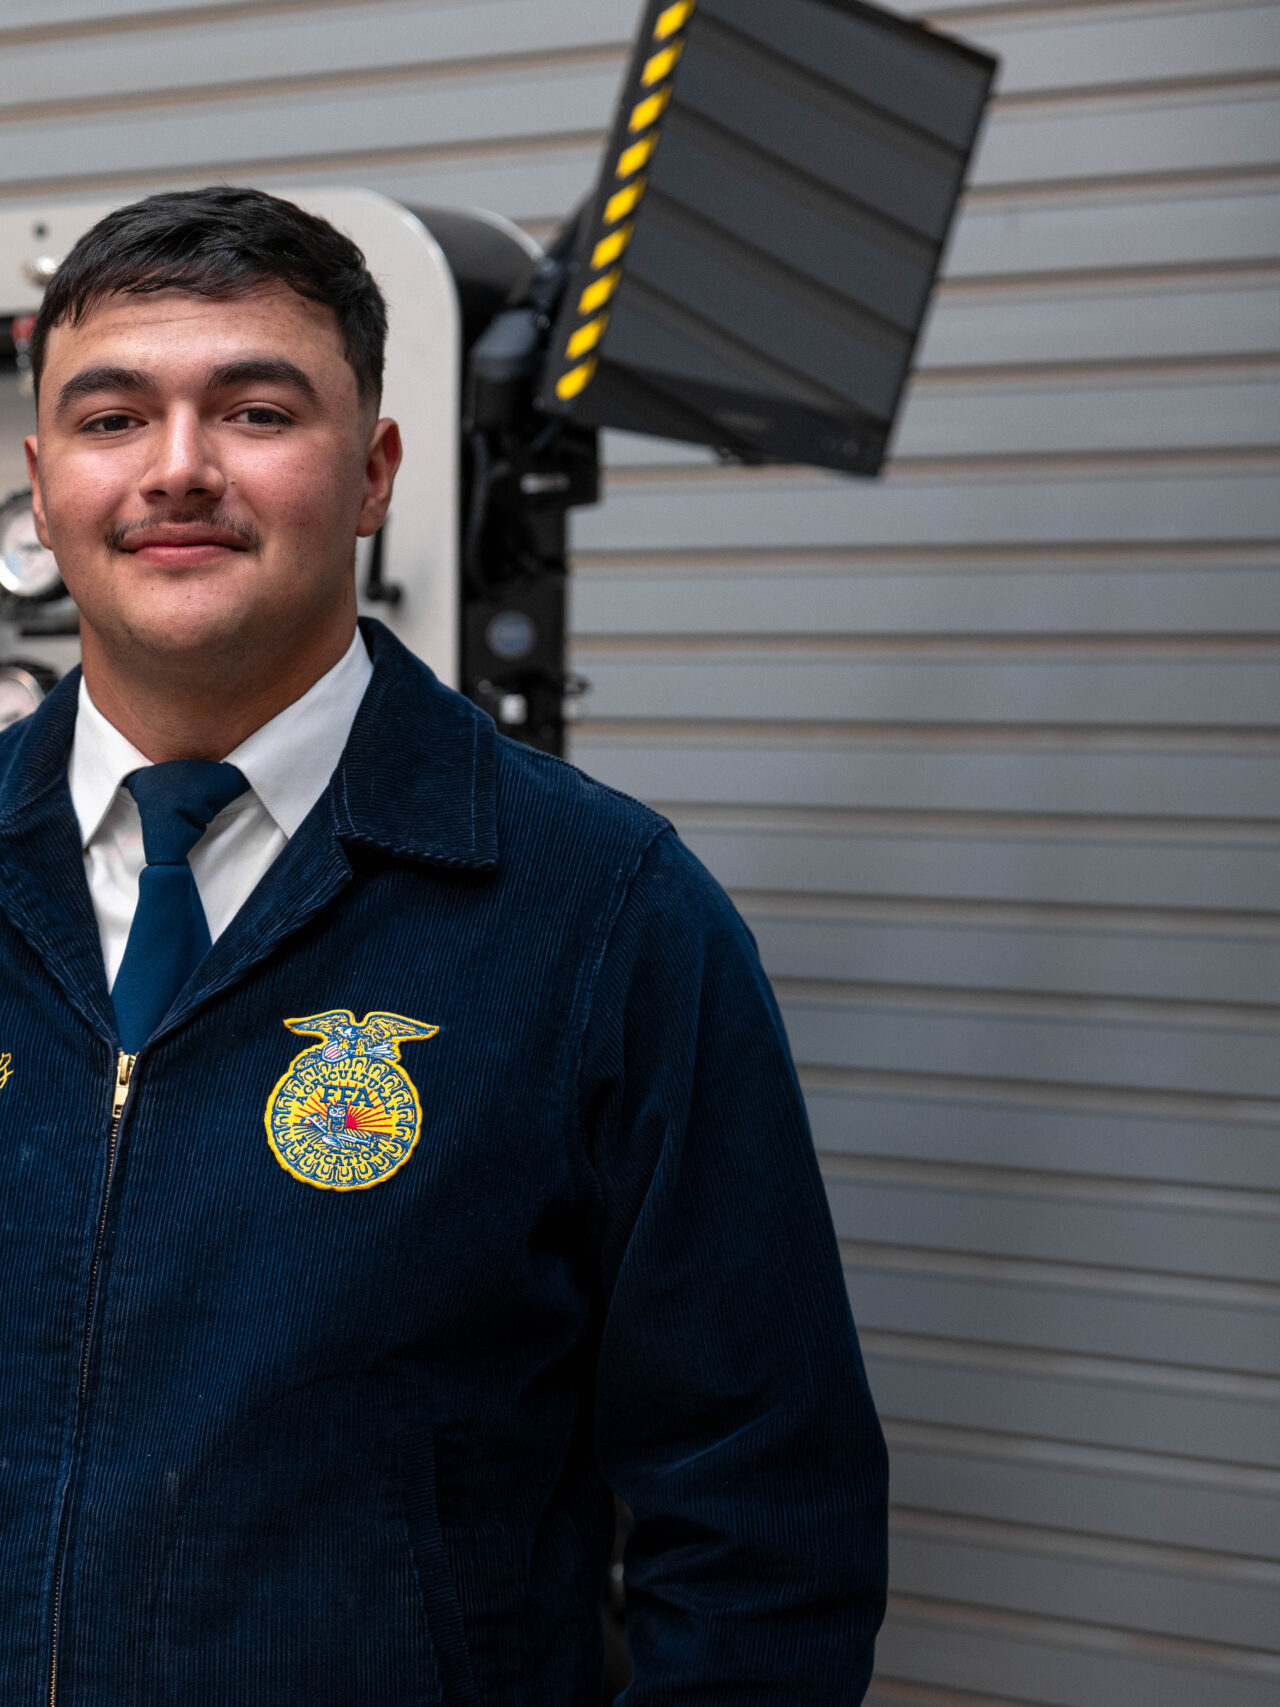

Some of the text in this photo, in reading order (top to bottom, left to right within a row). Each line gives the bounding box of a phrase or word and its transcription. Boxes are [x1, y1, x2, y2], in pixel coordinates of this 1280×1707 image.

[296, 1070, 395, 1115] AGRICULTURAL
[320, 1085, 375, 1107] FFA
[295, 1135, 383, 1167] EDUCATION
